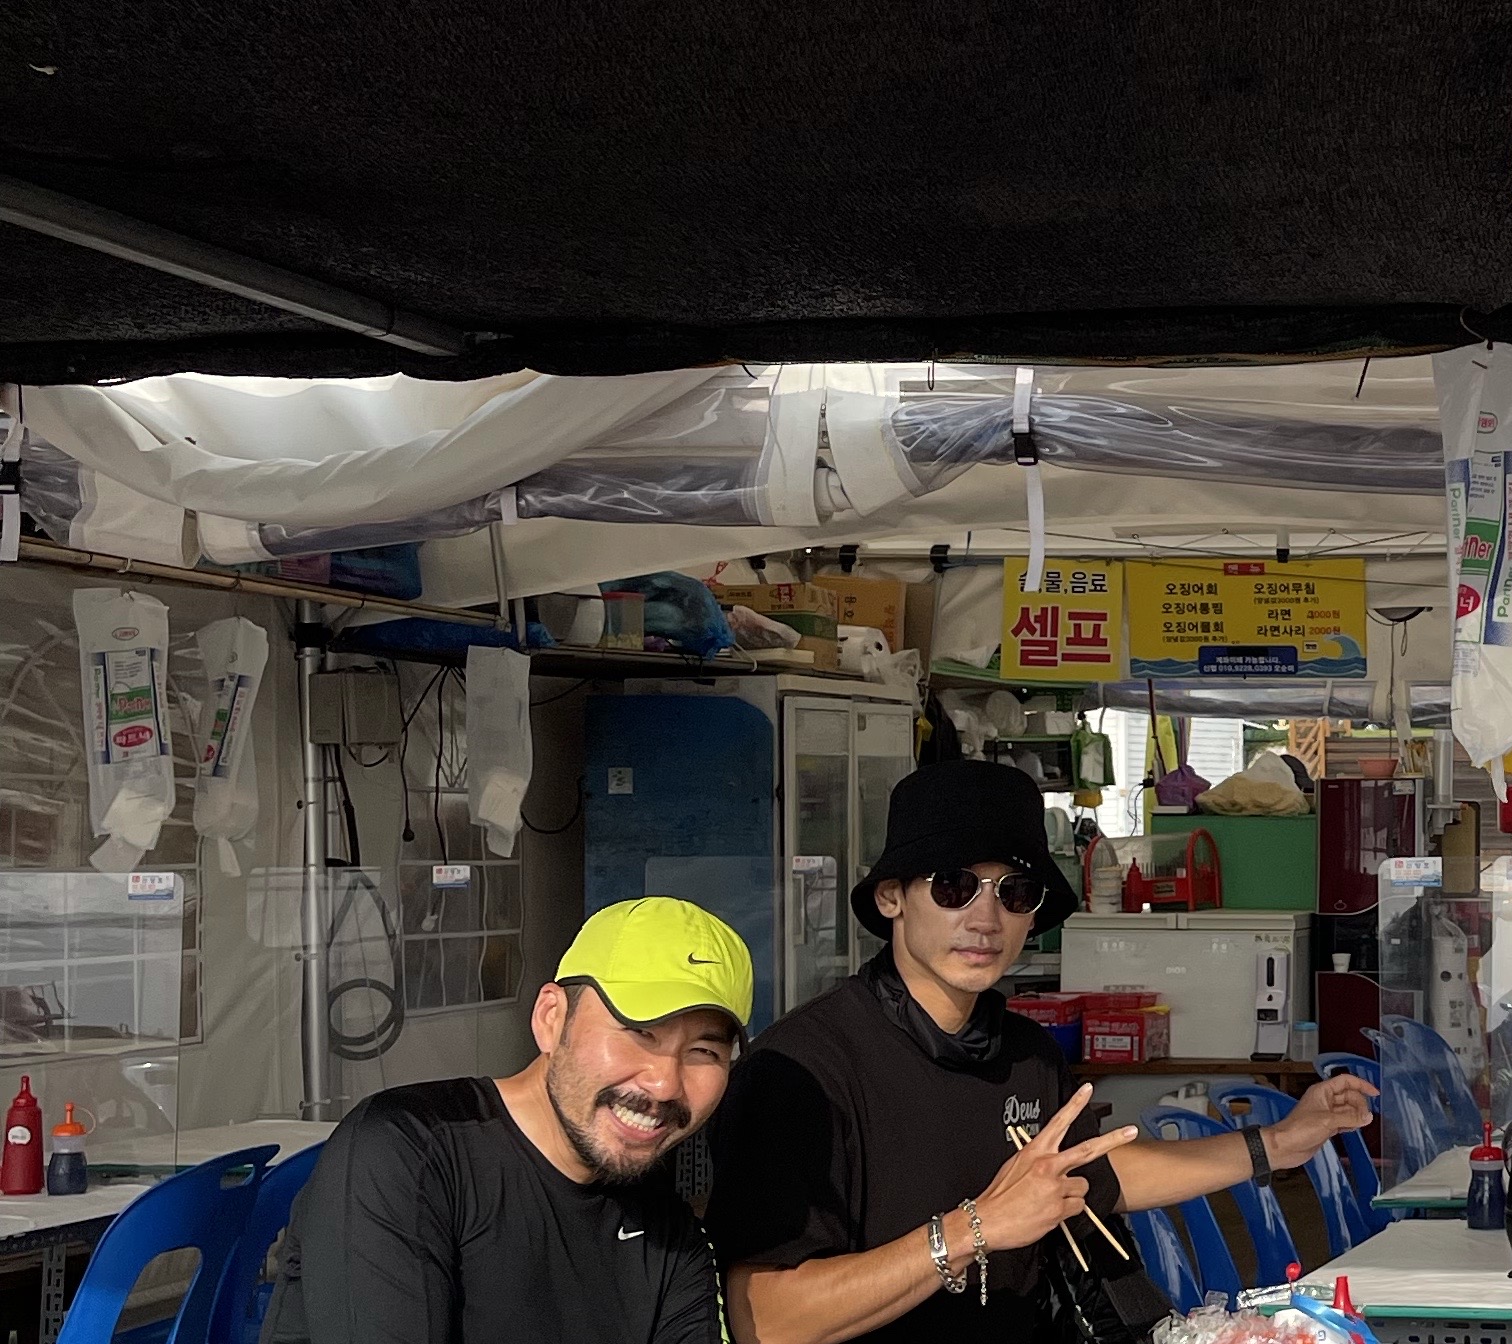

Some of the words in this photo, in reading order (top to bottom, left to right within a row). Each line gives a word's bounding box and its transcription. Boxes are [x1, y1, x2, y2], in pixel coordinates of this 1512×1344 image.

[1164, 582, 1218, 596] 오징어회
[1253, 582, 1316, 596] 오징어무침
[1267, 608, 1292, 621] 라면
[1162, 621, 1224, 634] 오징어물회
[1256, 625, 1306, 637] 라면사리
[1309, 626, 1341, 636] 2000원
[1010, 605, 1112, 668] 셀프
[1003, 1094, 1041, 1124] Deus
